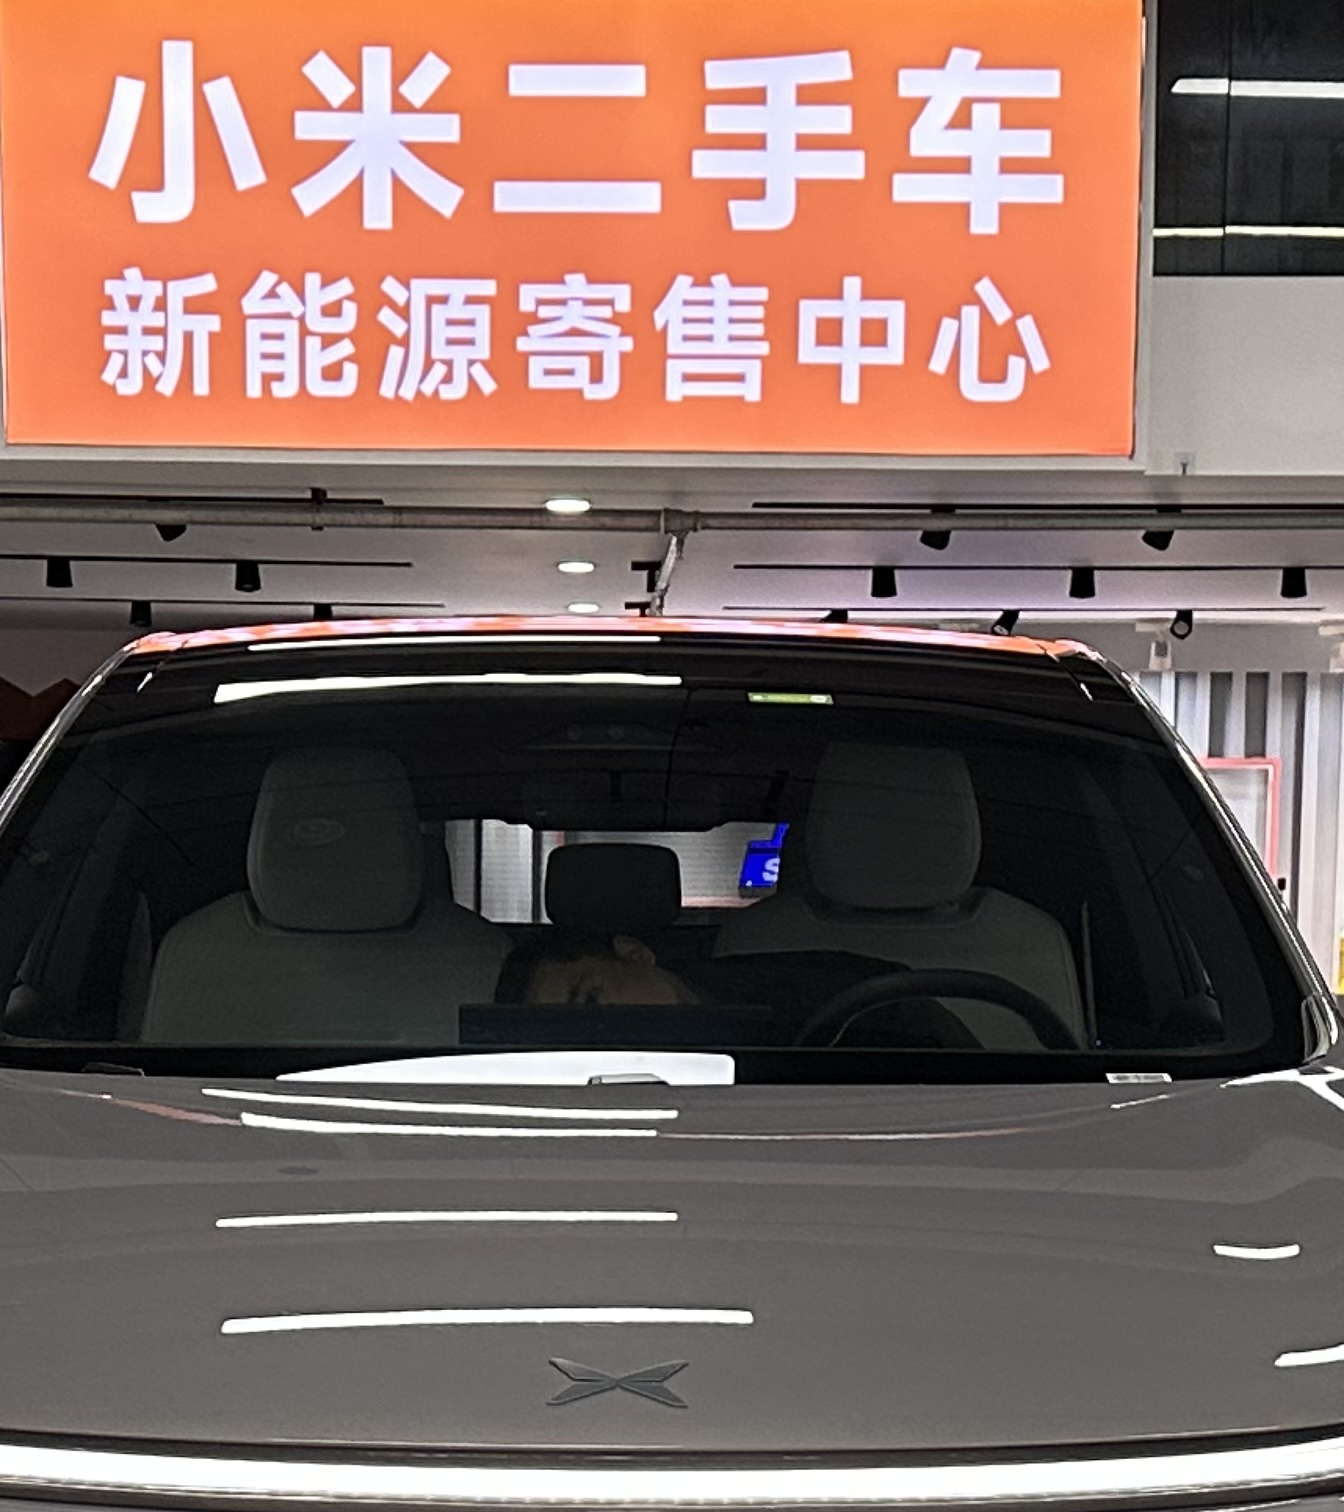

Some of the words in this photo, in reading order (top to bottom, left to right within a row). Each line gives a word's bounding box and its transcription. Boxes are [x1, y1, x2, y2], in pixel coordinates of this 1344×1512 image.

[89, 41, 1063, 234] 小米二手车
[102, 267, 1050, 403] 新能源寄售中心
